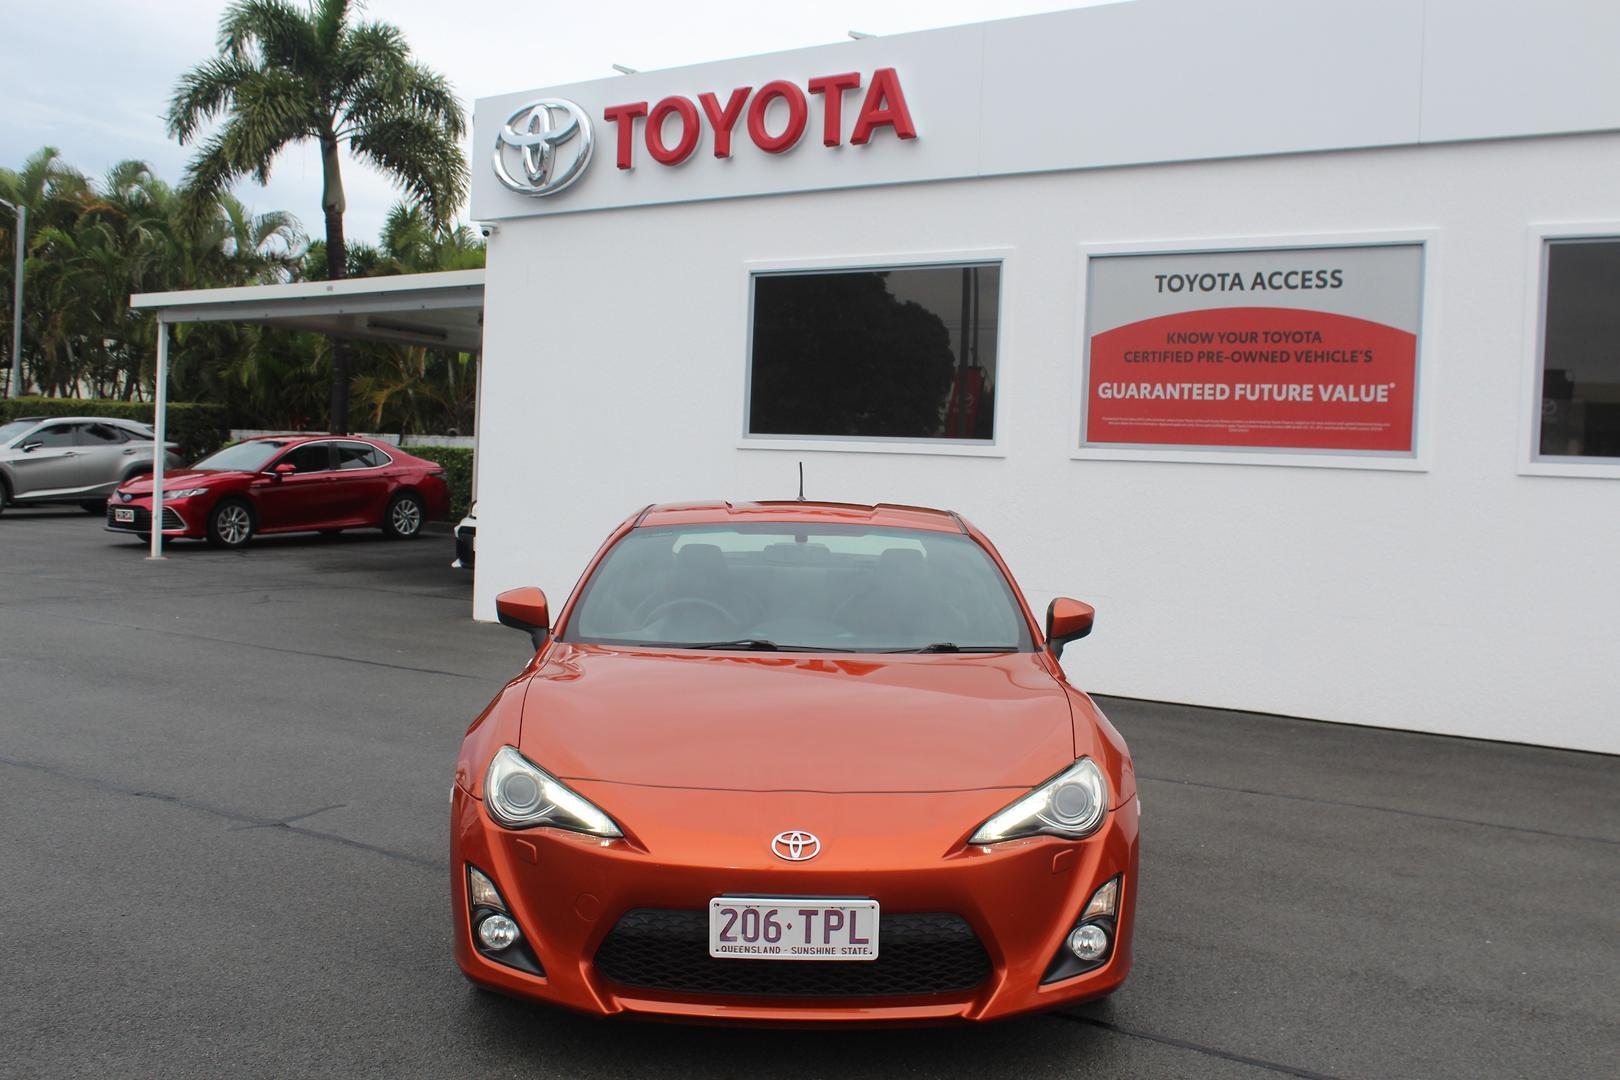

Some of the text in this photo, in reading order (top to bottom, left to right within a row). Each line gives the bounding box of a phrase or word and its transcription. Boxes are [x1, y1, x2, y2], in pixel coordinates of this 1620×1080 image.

[604, 67, 917, 170] TOYOTA
[1155, 269, 1344, 293] TOYOTA ACCESS
[1166, 330, 1323, 345] KNOW YOUR TOYOTA
[1123, 349, 1373, 363] CERTIFIED PRE-OWNED VEHICLE'S
[1097, 382, 1230, 400] GUARANTEED
[1234, 383, 1314, 402] FUTURE
[720, 945, 781, 954] QUEENSLAND
[791, 946, 836, 955] SUNSHINE
[841, 946, 868, 955] STATE
